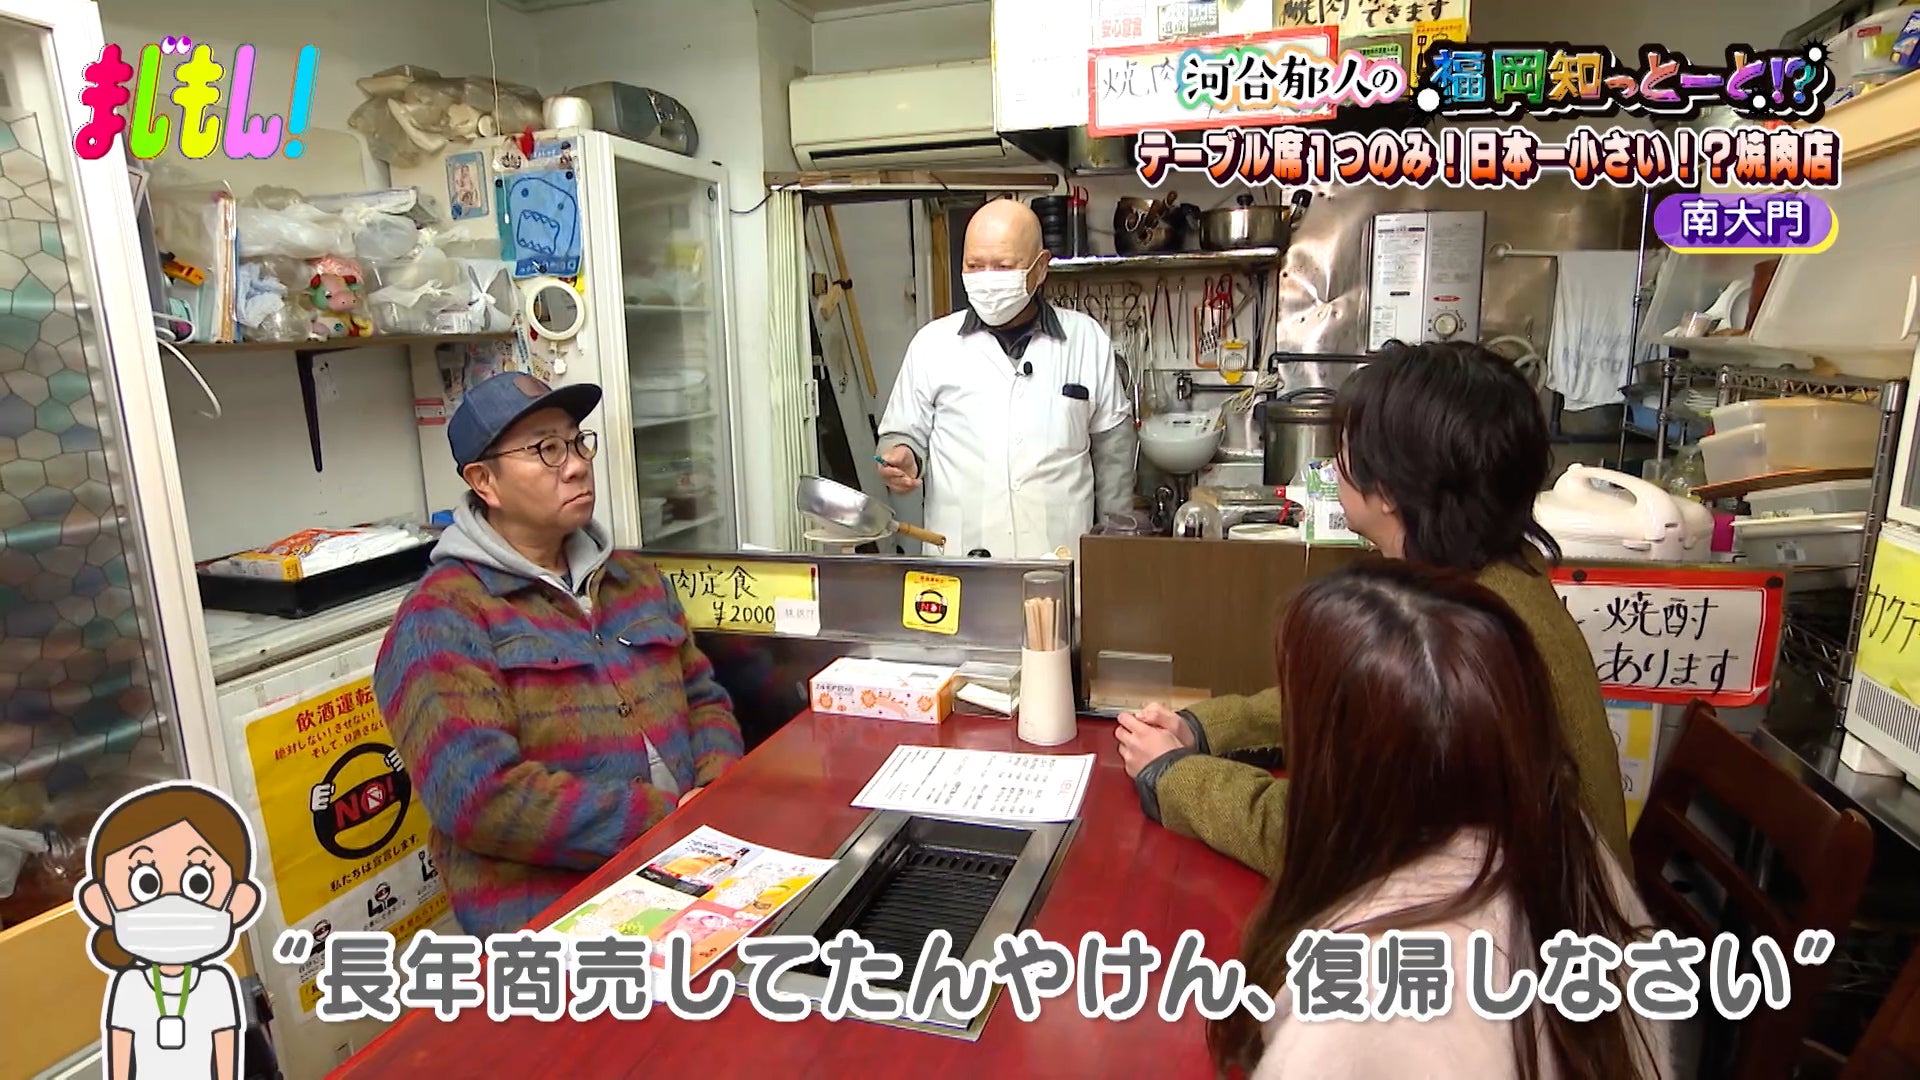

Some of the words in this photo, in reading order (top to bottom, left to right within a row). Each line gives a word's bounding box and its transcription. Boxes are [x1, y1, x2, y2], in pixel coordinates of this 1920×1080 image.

[1361, 1, 1450, 28] できます
[654, 562, 758, 600] 肉定食
[1596, 641, 1739, 696] あります
[295, 685, 375, 732] 飲酒運転
[334, 776, 396, 830] NO!
